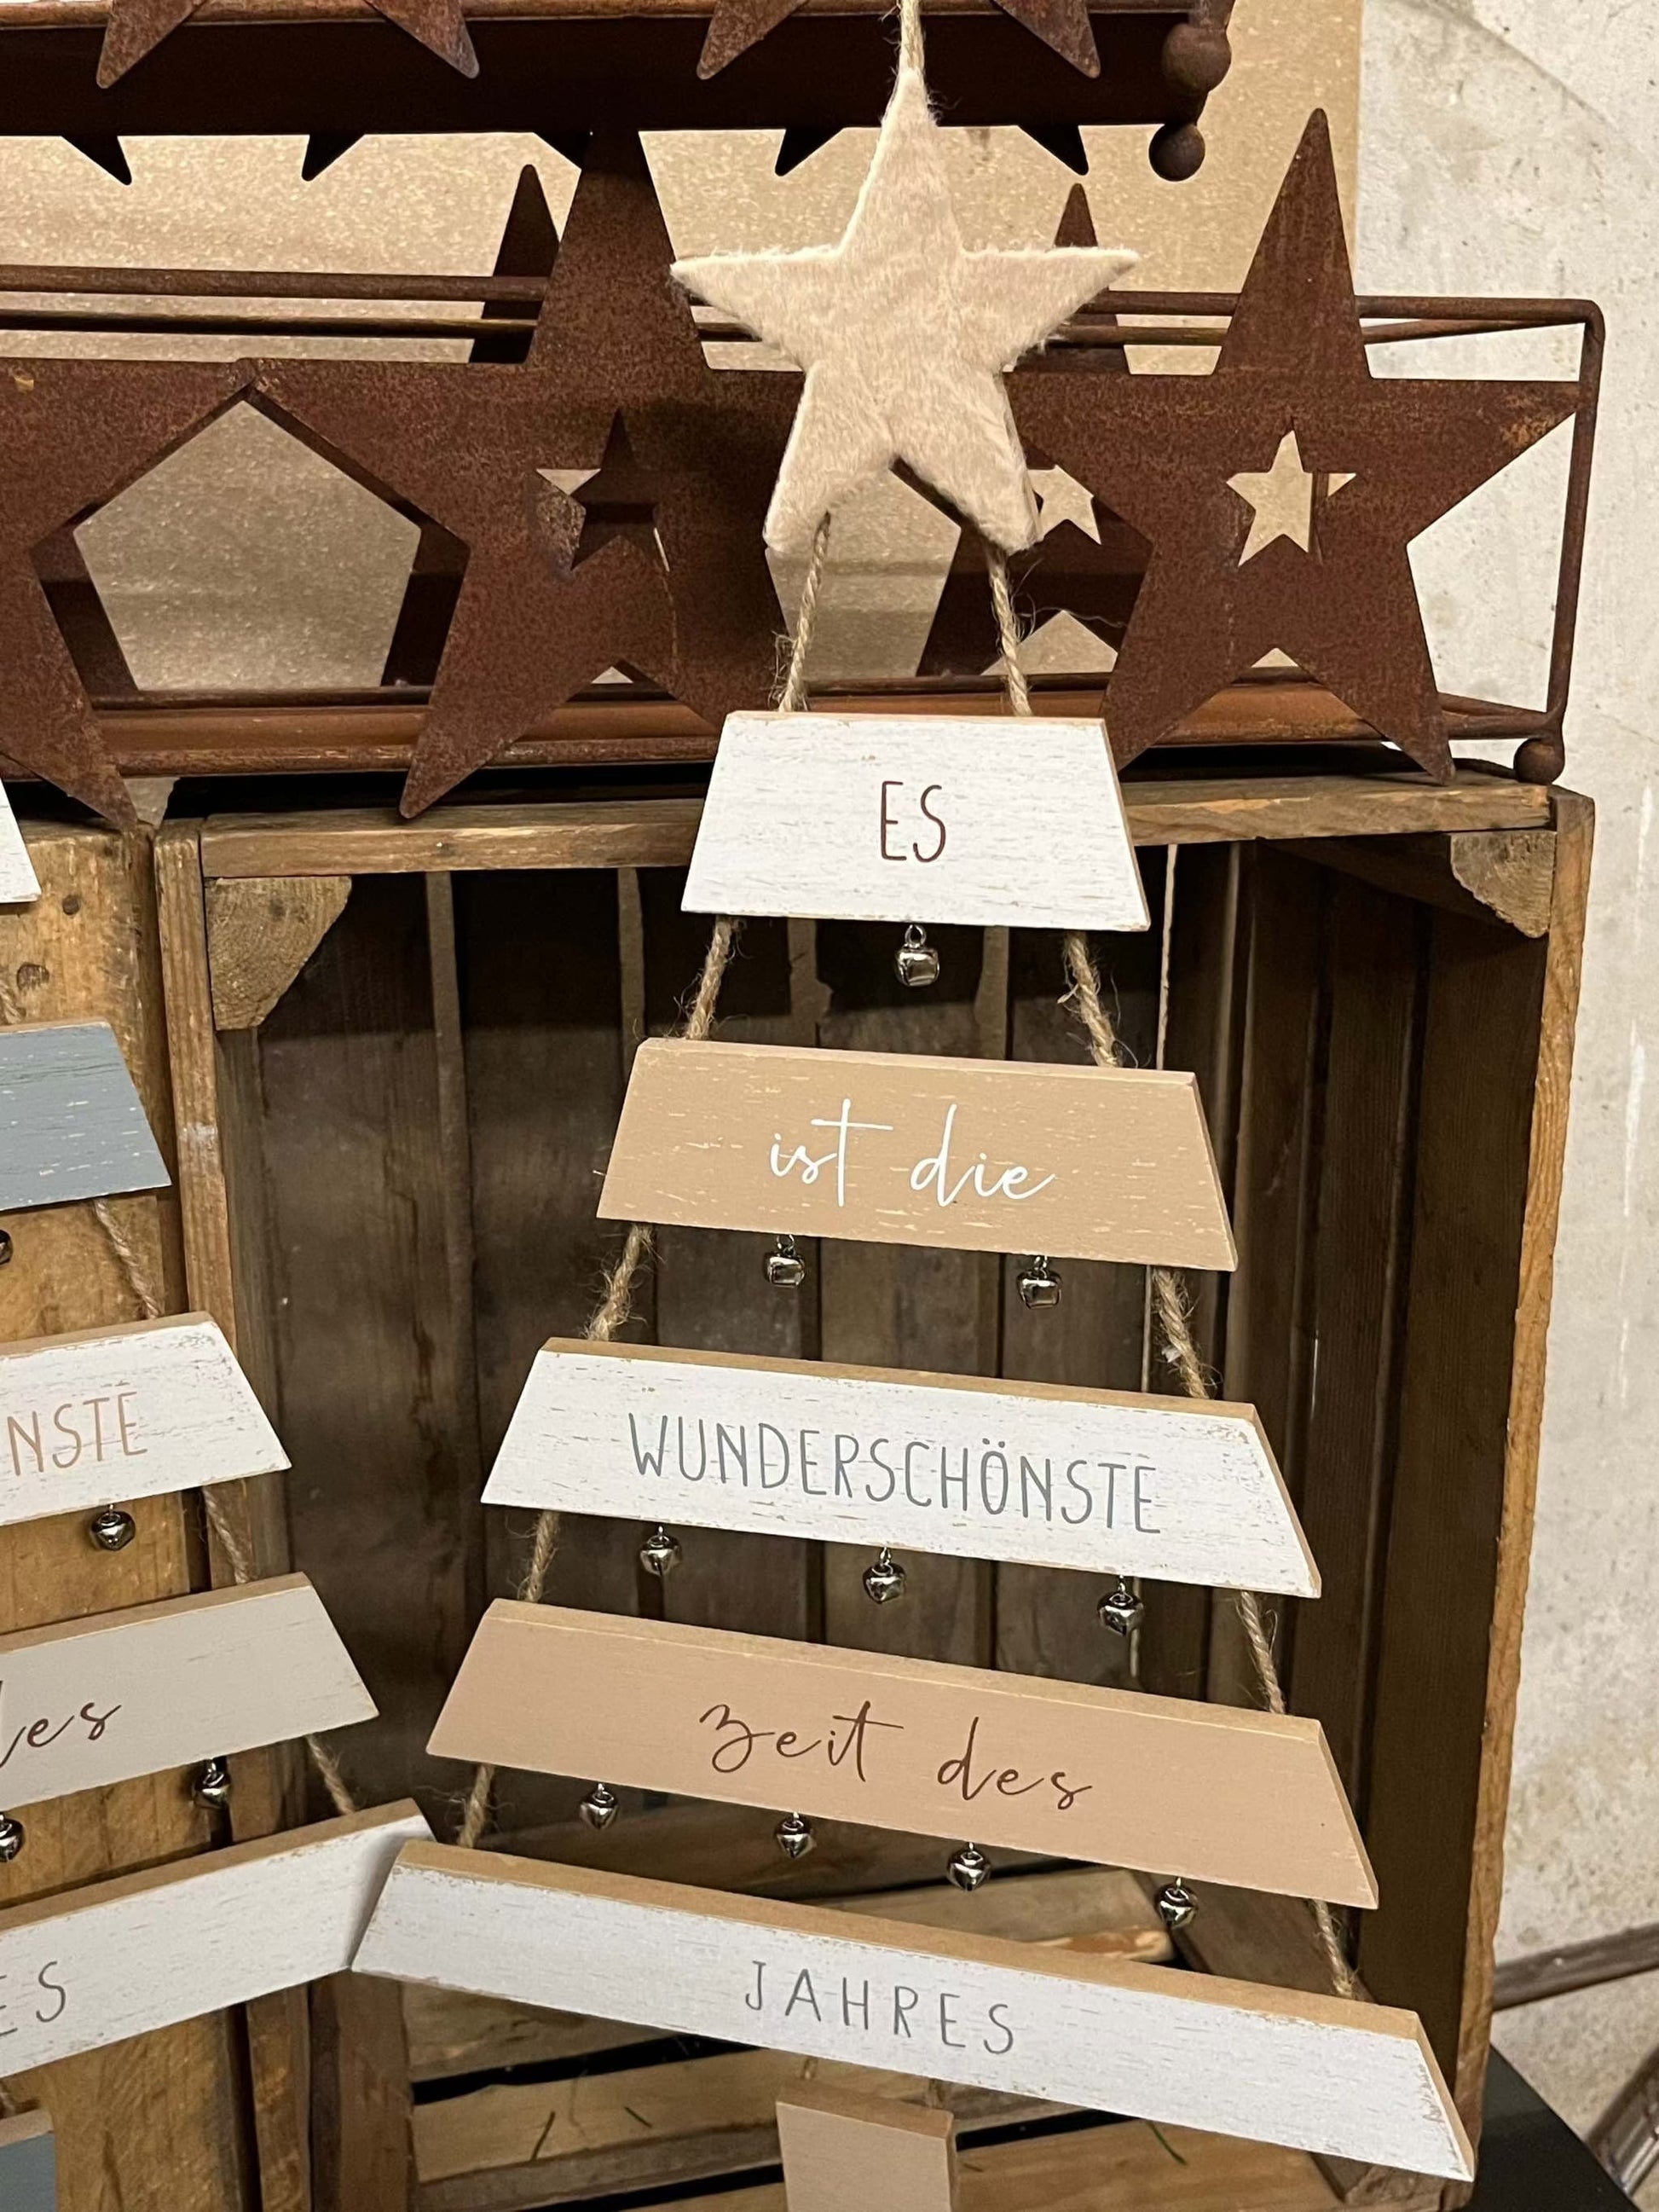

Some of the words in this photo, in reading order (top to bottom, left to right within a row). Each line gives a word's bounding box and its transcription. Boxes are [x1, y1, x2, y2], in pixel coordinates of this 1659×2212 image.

[881, 780, 946, 863] ES
[770, 1098, 893, 1207] ist
[910, 1103, 1055, 1207] die
[7, 1391, 147, 1476] NSTE
[628, 1412, 1160, 1534] WUNDERSCHÖNSTE
[0, 1680, 122, 1768] es
[937, 1717, 1093, 1810] des
[745, 1960, 1014, 2054] JAHRES
